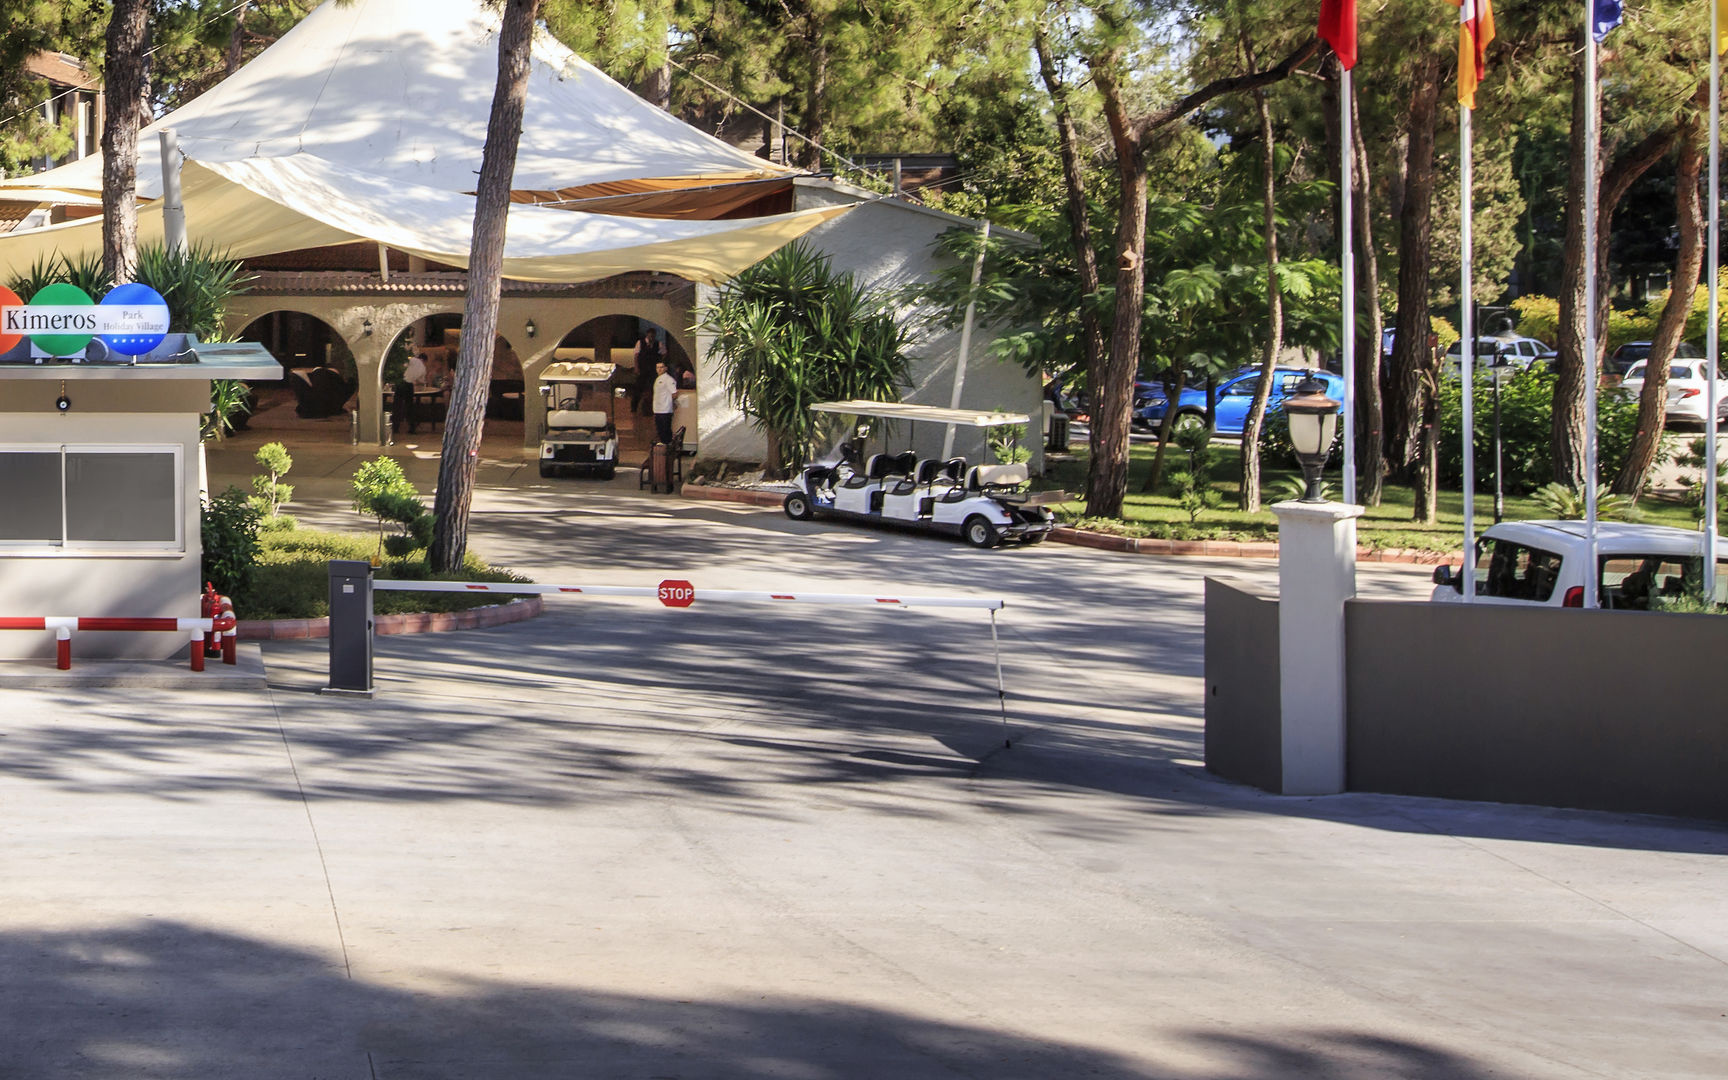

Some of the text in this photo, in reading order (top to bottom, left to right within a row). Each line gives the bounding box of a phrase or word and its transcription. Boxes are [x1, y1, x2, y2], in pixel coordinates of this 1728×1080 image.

[6, 310, 96, 330] Kimeros
[122, 310, 144, 320] Park
[103, 322, 164, 332] Holiday Village
[659, 587, 693, 600] STOP
